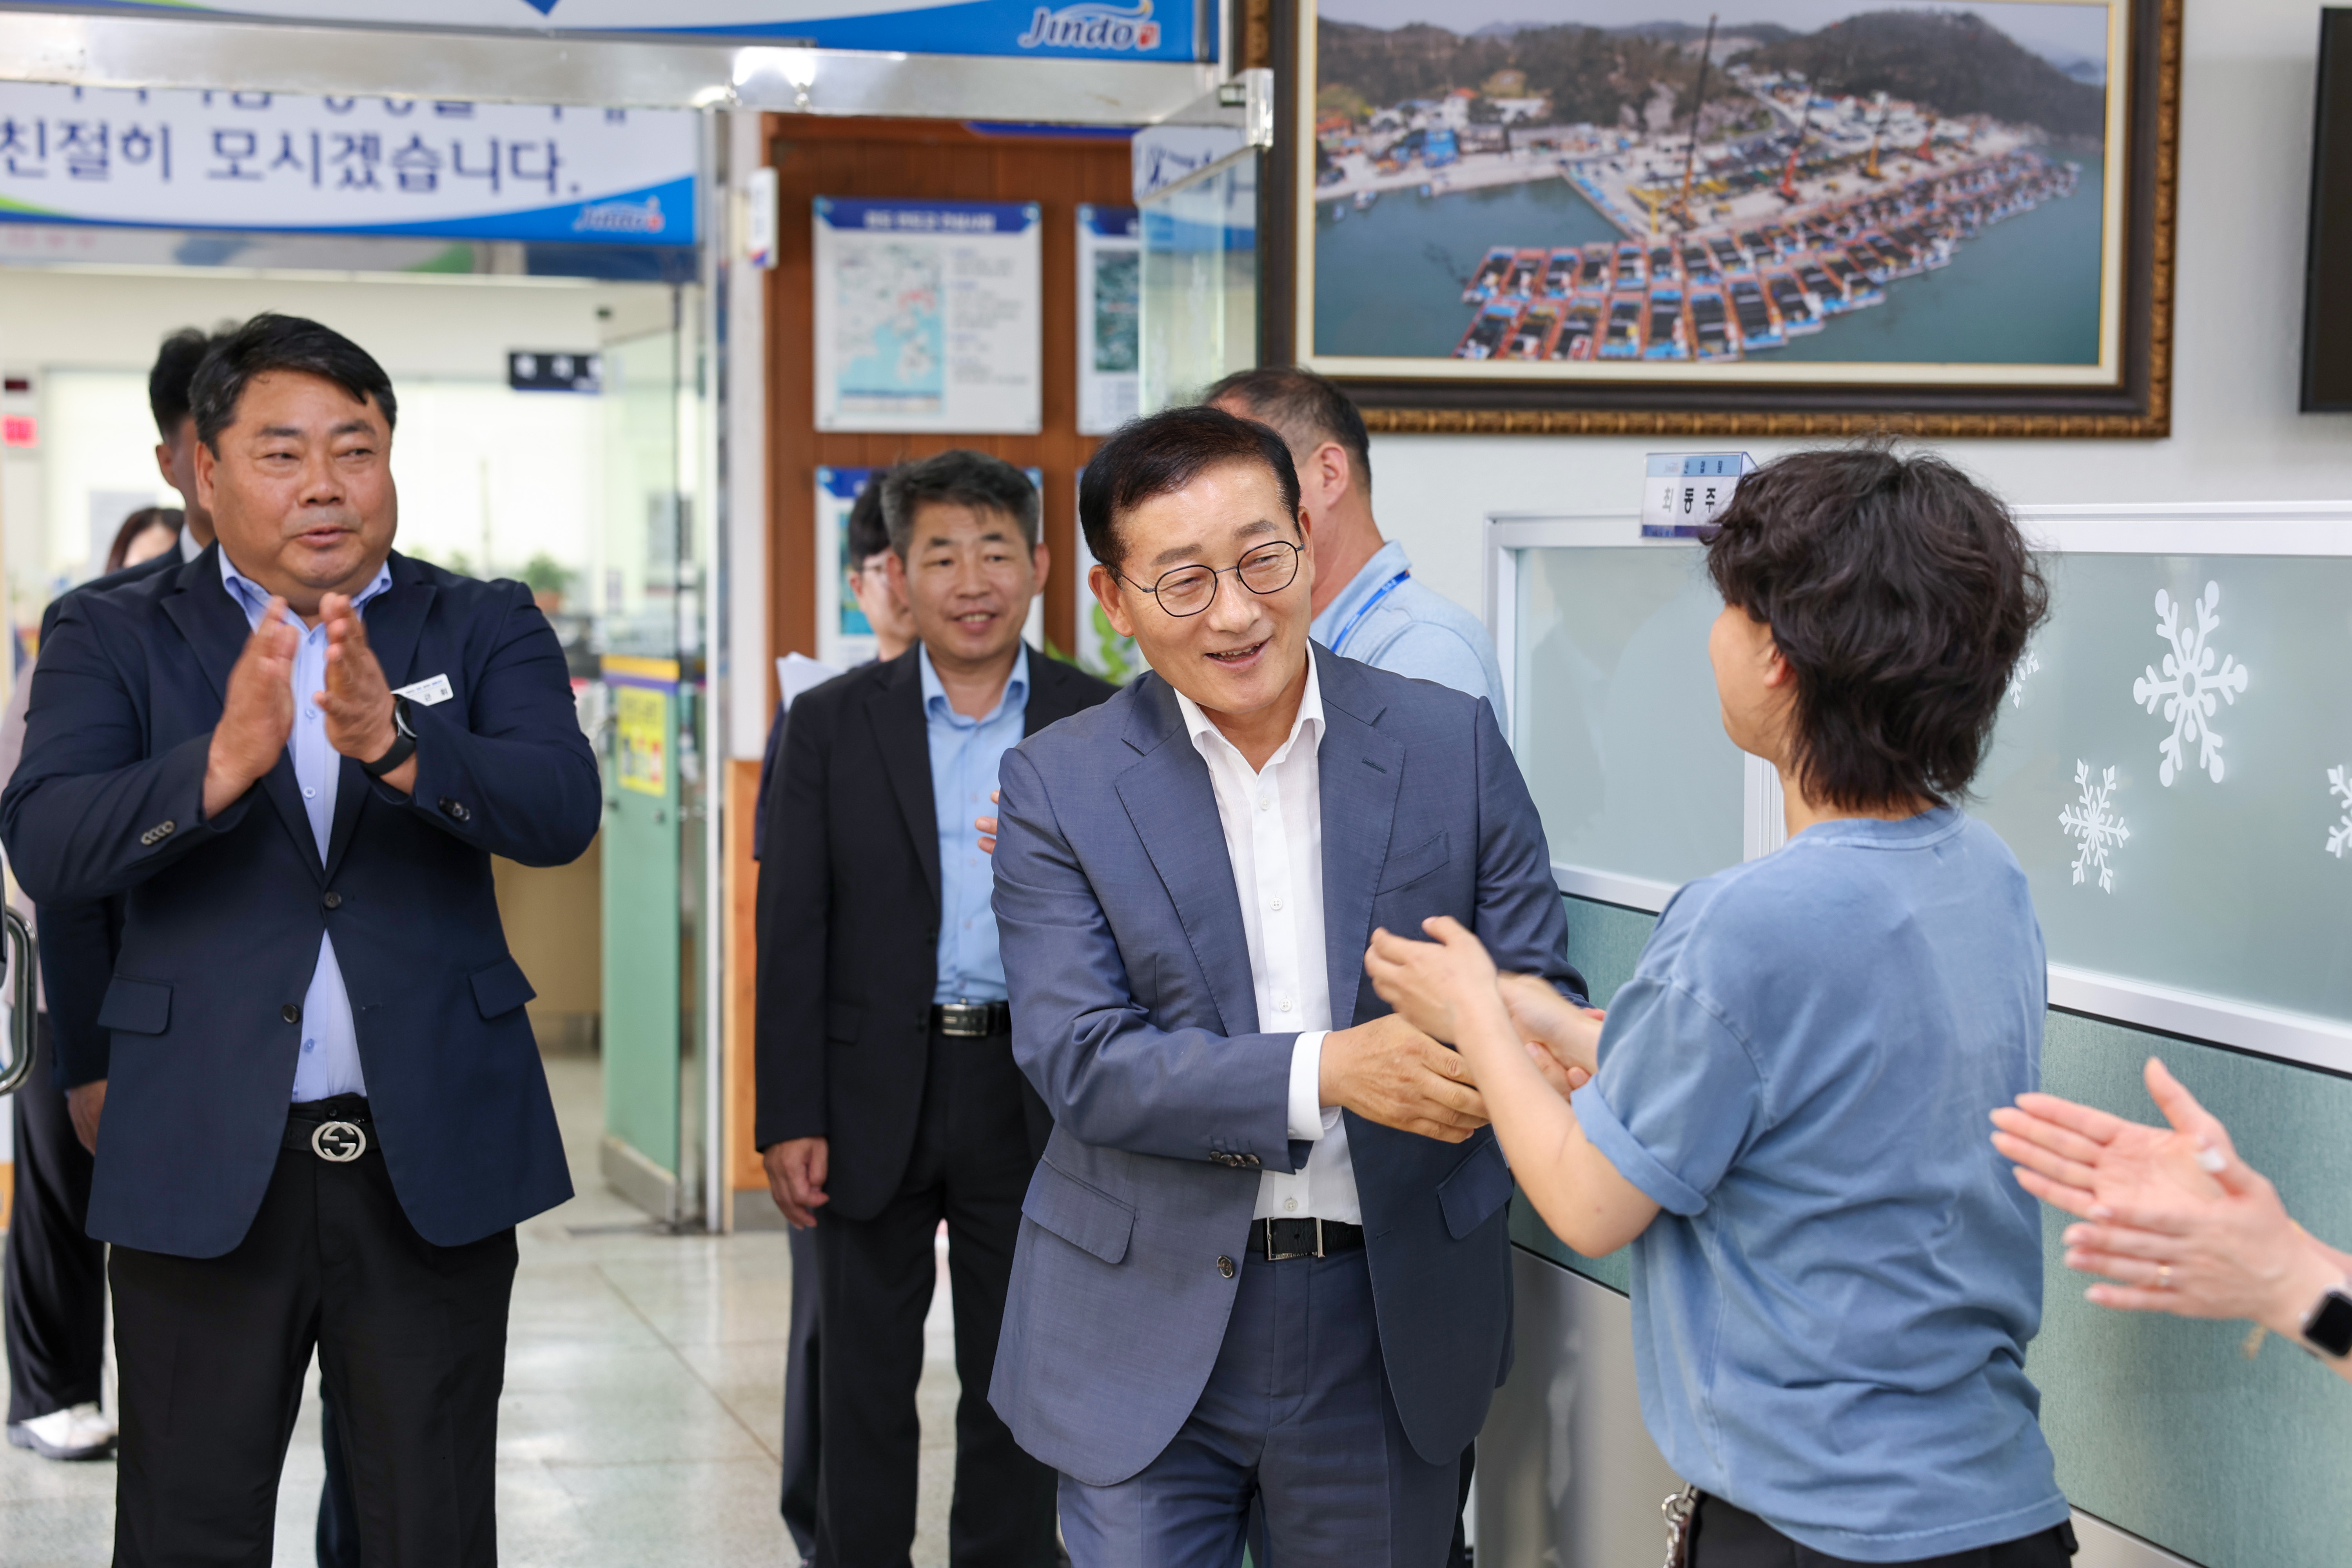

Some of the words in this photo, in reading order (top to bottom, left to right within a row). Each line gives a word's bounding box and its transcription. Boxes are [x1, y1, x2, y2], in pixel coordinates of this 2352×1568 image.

[1019, 8, 1135, 48] Jindo
[0, 118, 172, 183] 친절히
[205, 127, 580, 194] 모시겠습니다.
